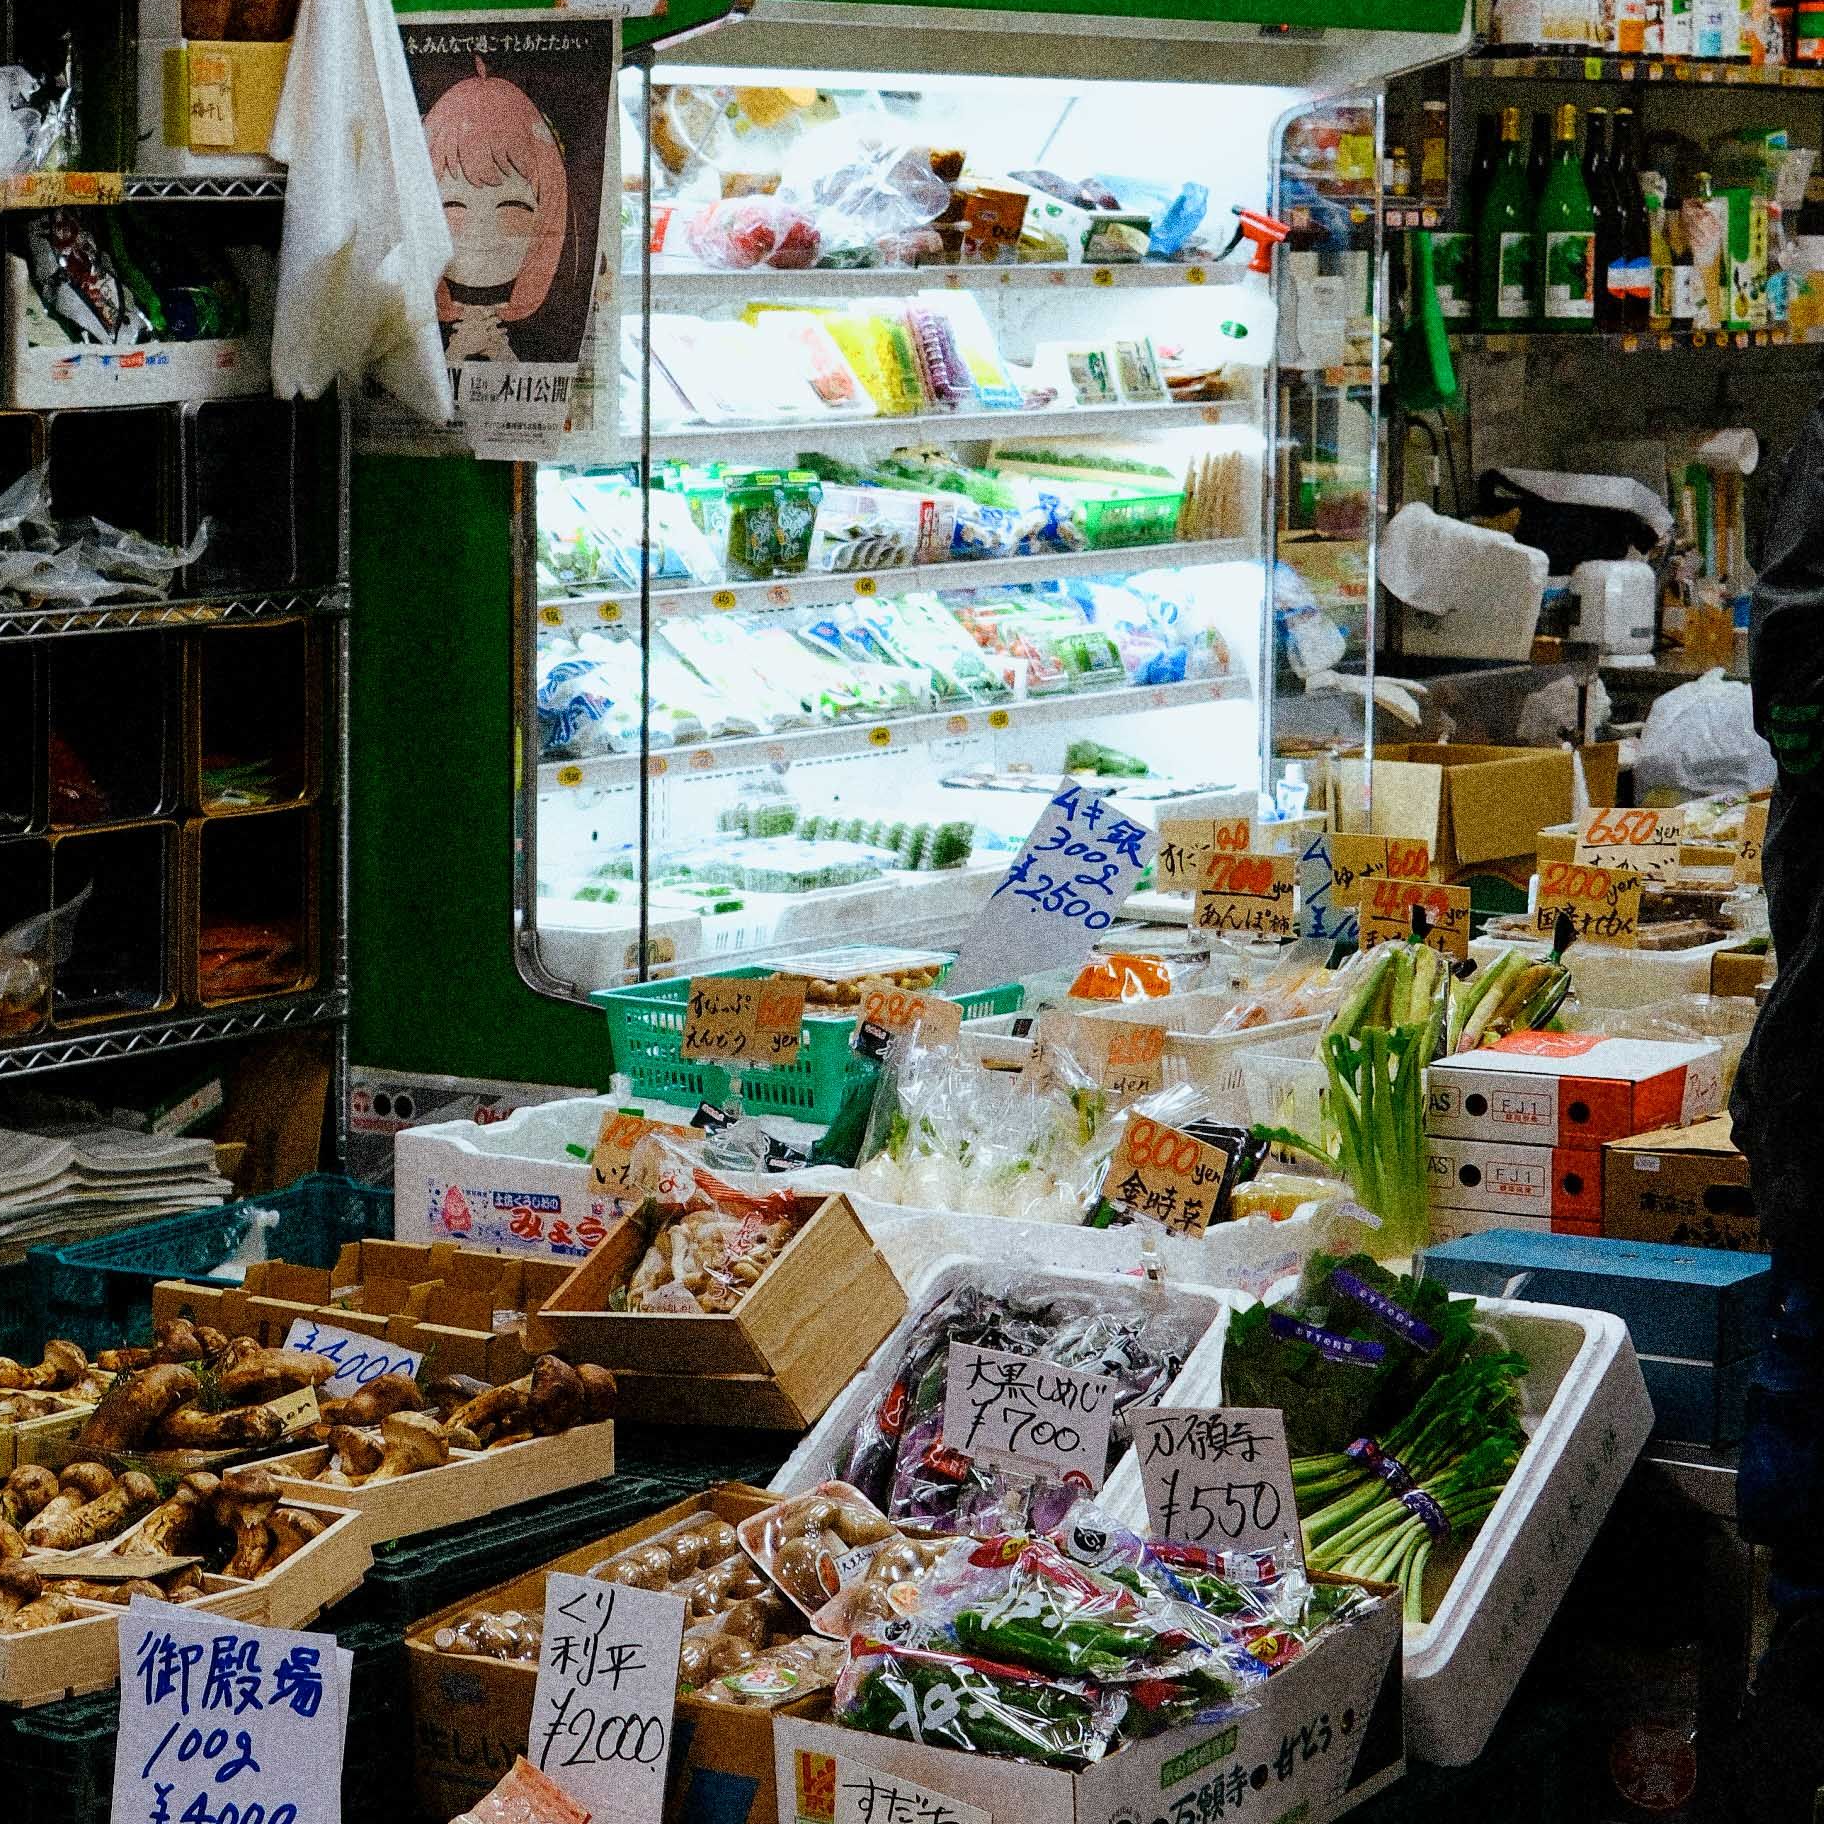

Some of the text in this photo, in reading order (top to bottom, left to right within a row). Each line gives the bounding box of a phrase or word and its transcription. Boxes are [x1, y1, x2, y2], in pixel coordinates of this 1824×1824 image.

[1586, 807, 1659, 845] 650
[1542, 863, 1612, 900] 200
[1129, 1120, 1200, 1174] 800
[1116, 1170, 1204, 1231] 金時草
[558, 1588, 615, 1636] くり
[137, 1631, 324, 1717] 御殿場
[550, 1634, 646, 1691] 利平
[142, 1723, 260, 1783] 100g
